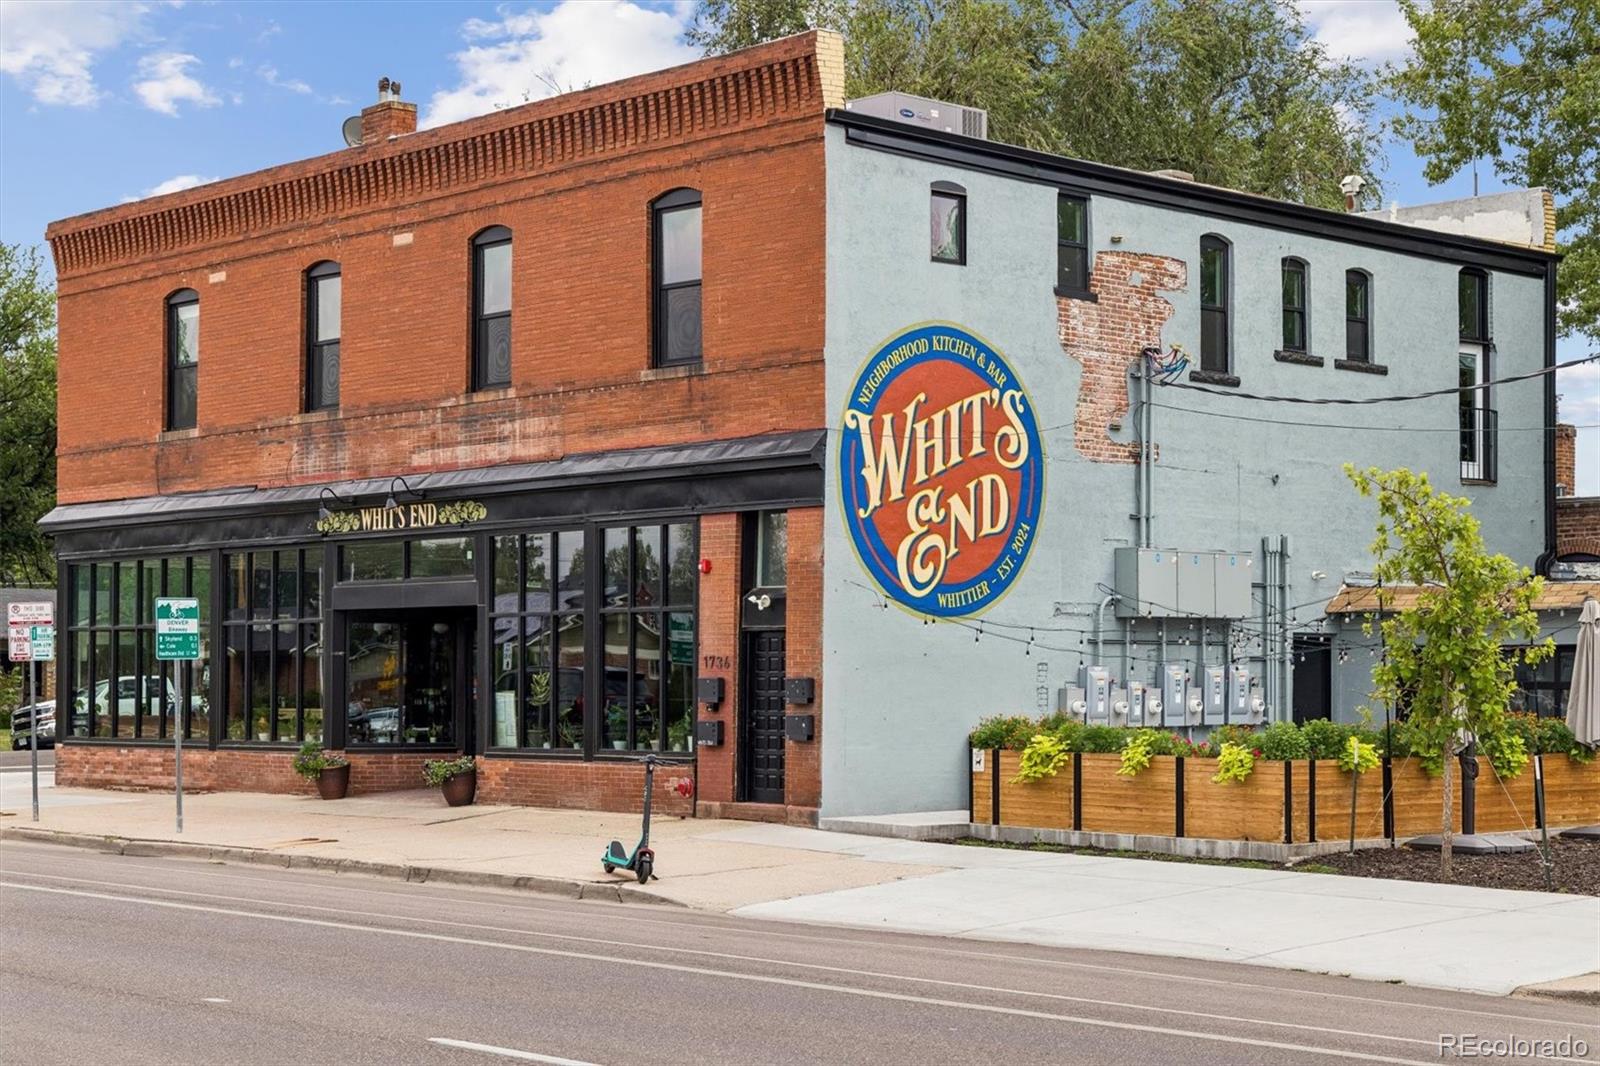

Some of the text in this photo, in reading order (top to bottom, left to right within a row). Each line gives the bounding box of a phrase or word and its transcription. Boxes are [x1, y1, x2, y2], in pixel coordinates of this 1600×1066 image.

[858, 335, 1008, 408] NEIGHBORHOOD KITCHEN & BAR
[844, 388, 1029, 519] WHIT'S
[360, 503, 437, 531] WHIT'S END
[896, 473, 1010, 598] END
[937, 580, 991, 608] WHITTIER
[996, 554, 1018, 580] EST.
[1011, 522, 1031, 555] 2024
[16, 628, 25, 636] NO
[704, 655, 730, 669] 1736
